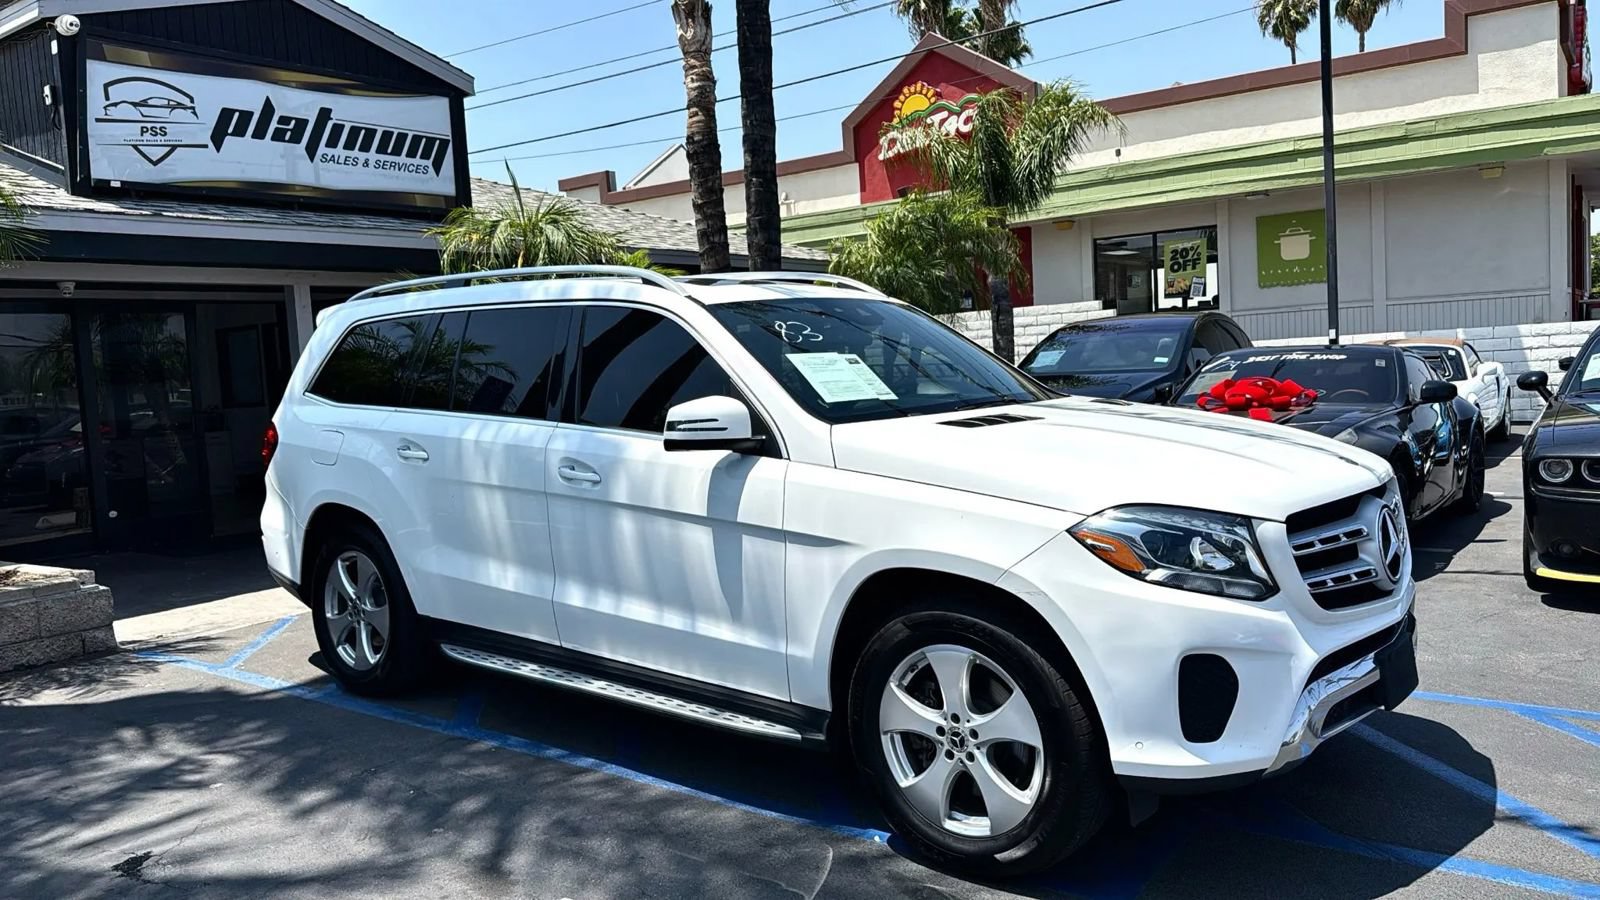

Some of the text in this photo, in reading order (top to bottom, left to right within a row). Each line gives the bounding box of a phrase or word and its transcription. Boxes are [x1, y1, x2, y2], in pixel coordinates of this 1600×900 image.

[140, 126, 168, 137] PSS
[926, 110, 979, 137] TAC
[210, 95, 450, 178] platinum
[320, 153, 430, 175] SALES & SERVICES
[1170, 245, 1202, 261] 20%
[1170, 258, 1202, 273] OFF
[774, 321, 823, 343] 83
